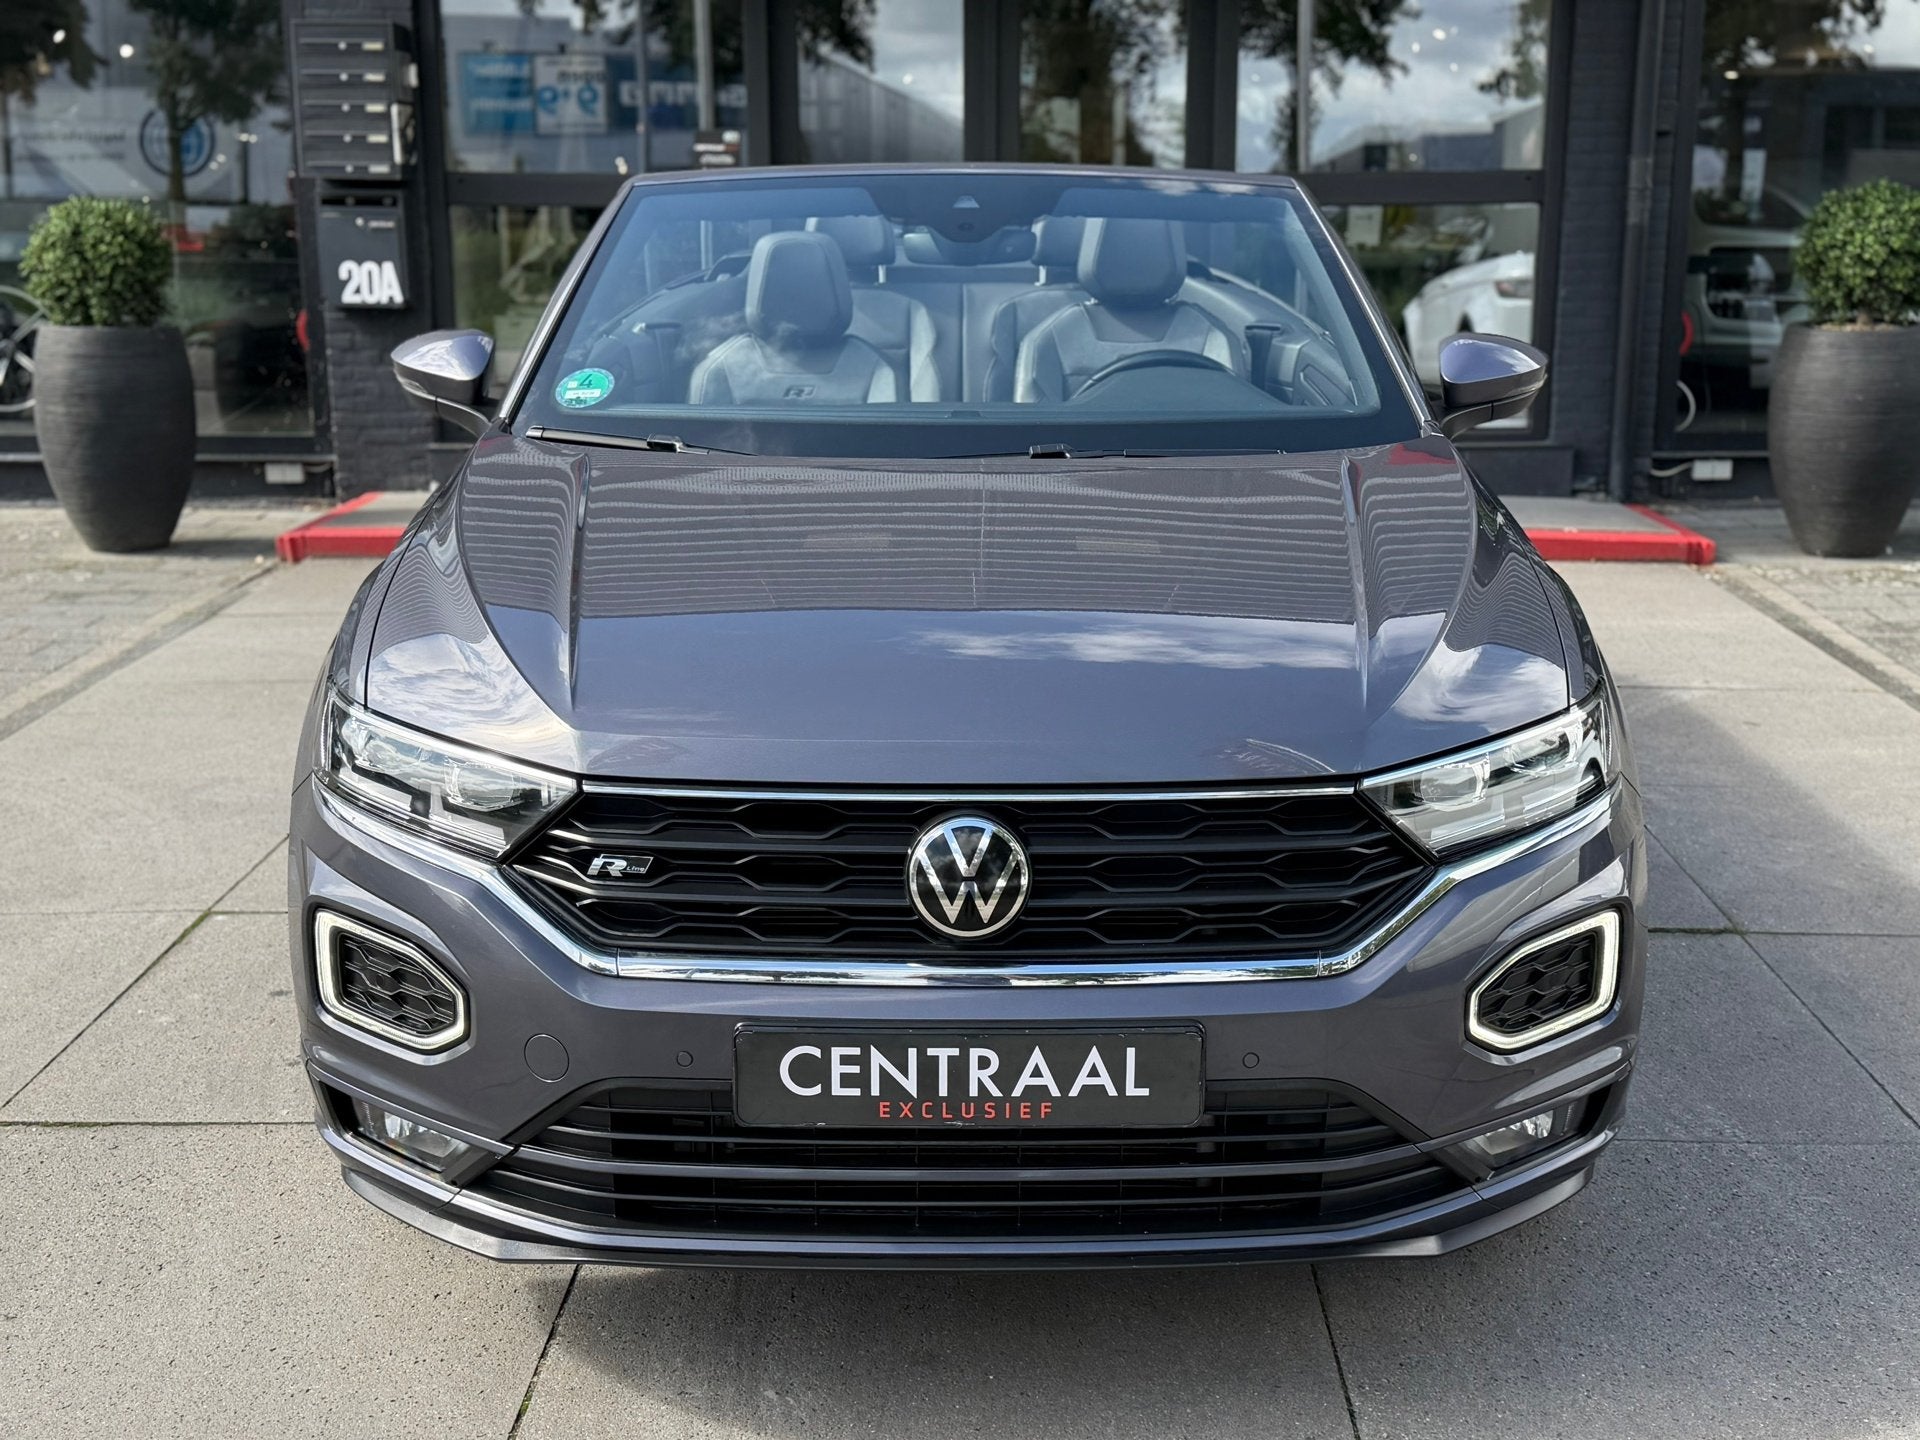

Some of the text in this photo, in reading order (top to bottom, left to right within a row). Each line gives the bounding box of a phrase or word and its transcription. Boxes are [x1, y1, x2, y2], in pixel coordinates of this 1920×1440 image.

[338, 259, 405, 305] 20A
[578, 373, 593, 388] 4
[918, 826, 1020, 925] VW
[779, 1044, 1150, 1098] CENTRAAL
[879, 1101, 1054, 1119] EXCLUSIEF
